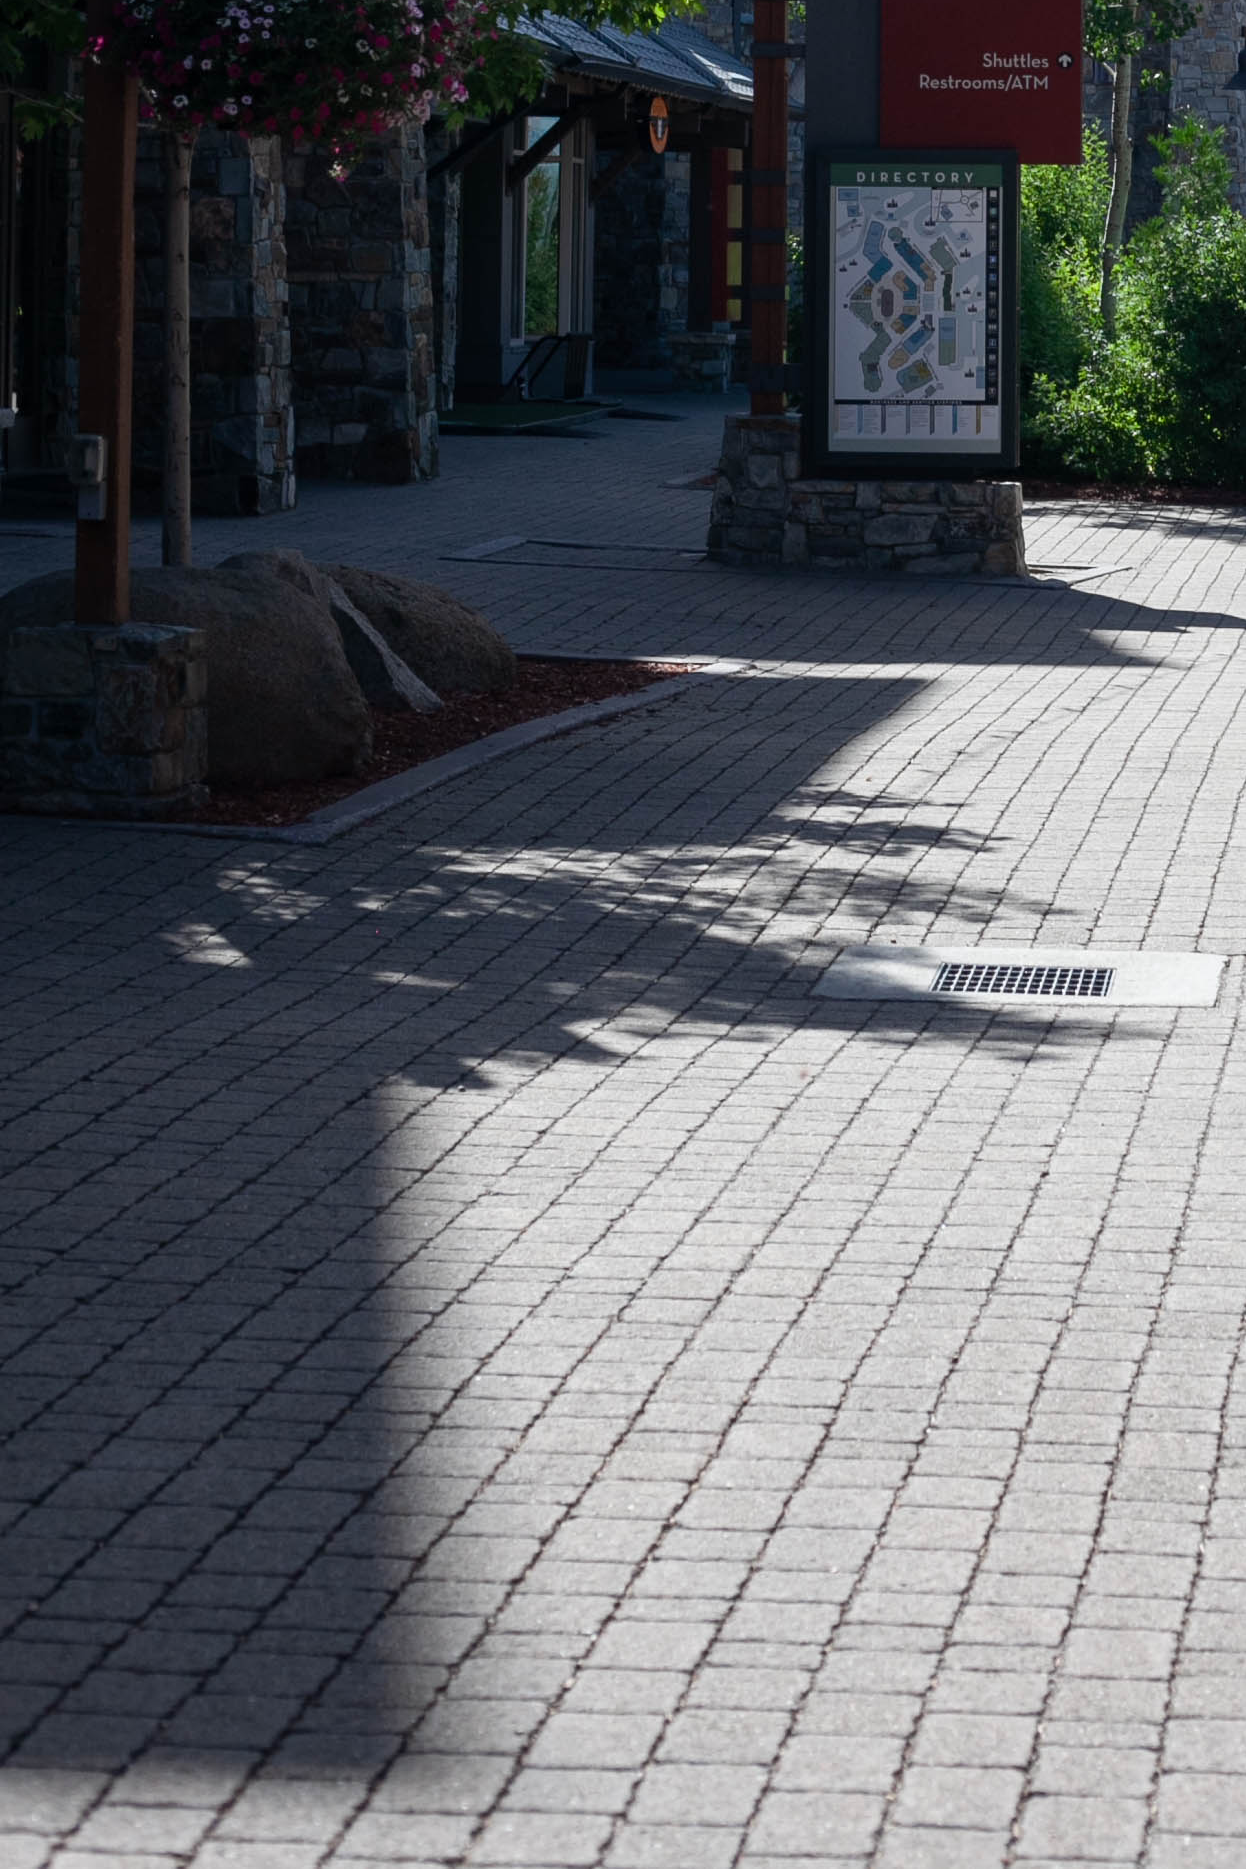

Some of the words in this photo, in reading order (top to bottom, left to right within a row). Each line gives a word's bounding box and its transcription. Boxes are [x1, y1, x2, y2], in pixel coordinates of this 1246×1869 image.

[982, 52, 1050, 69] Shuttles
[919, 73, 1049, 92] Restrooms/ATM
[856, 171, 974, 183] DIRECTORY
